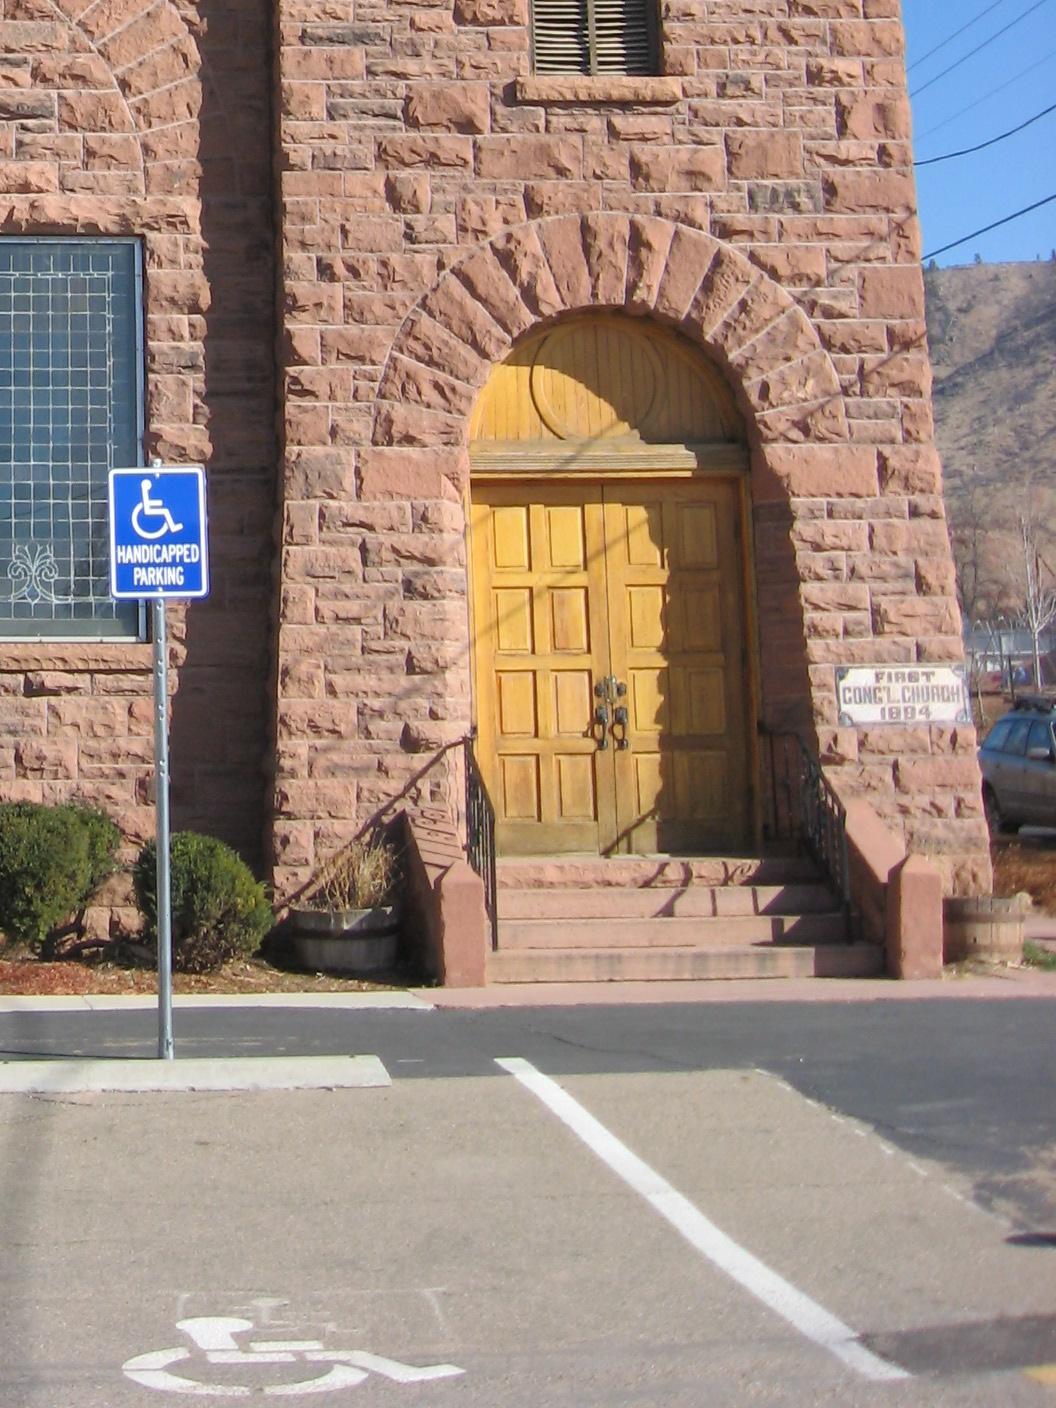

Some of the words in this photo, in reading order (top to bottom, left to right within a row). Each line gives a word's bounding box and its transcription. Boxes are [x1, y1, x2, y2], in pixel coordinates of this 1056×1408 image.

[117, 544, 199, 564] HANDICAPPED
[133, 566, 184, 586] PARKING
[874, 670, 936, 683] FIRST
[902, 683, 961, 704] CHURCH
[880, 705, 932, 720] 1894
